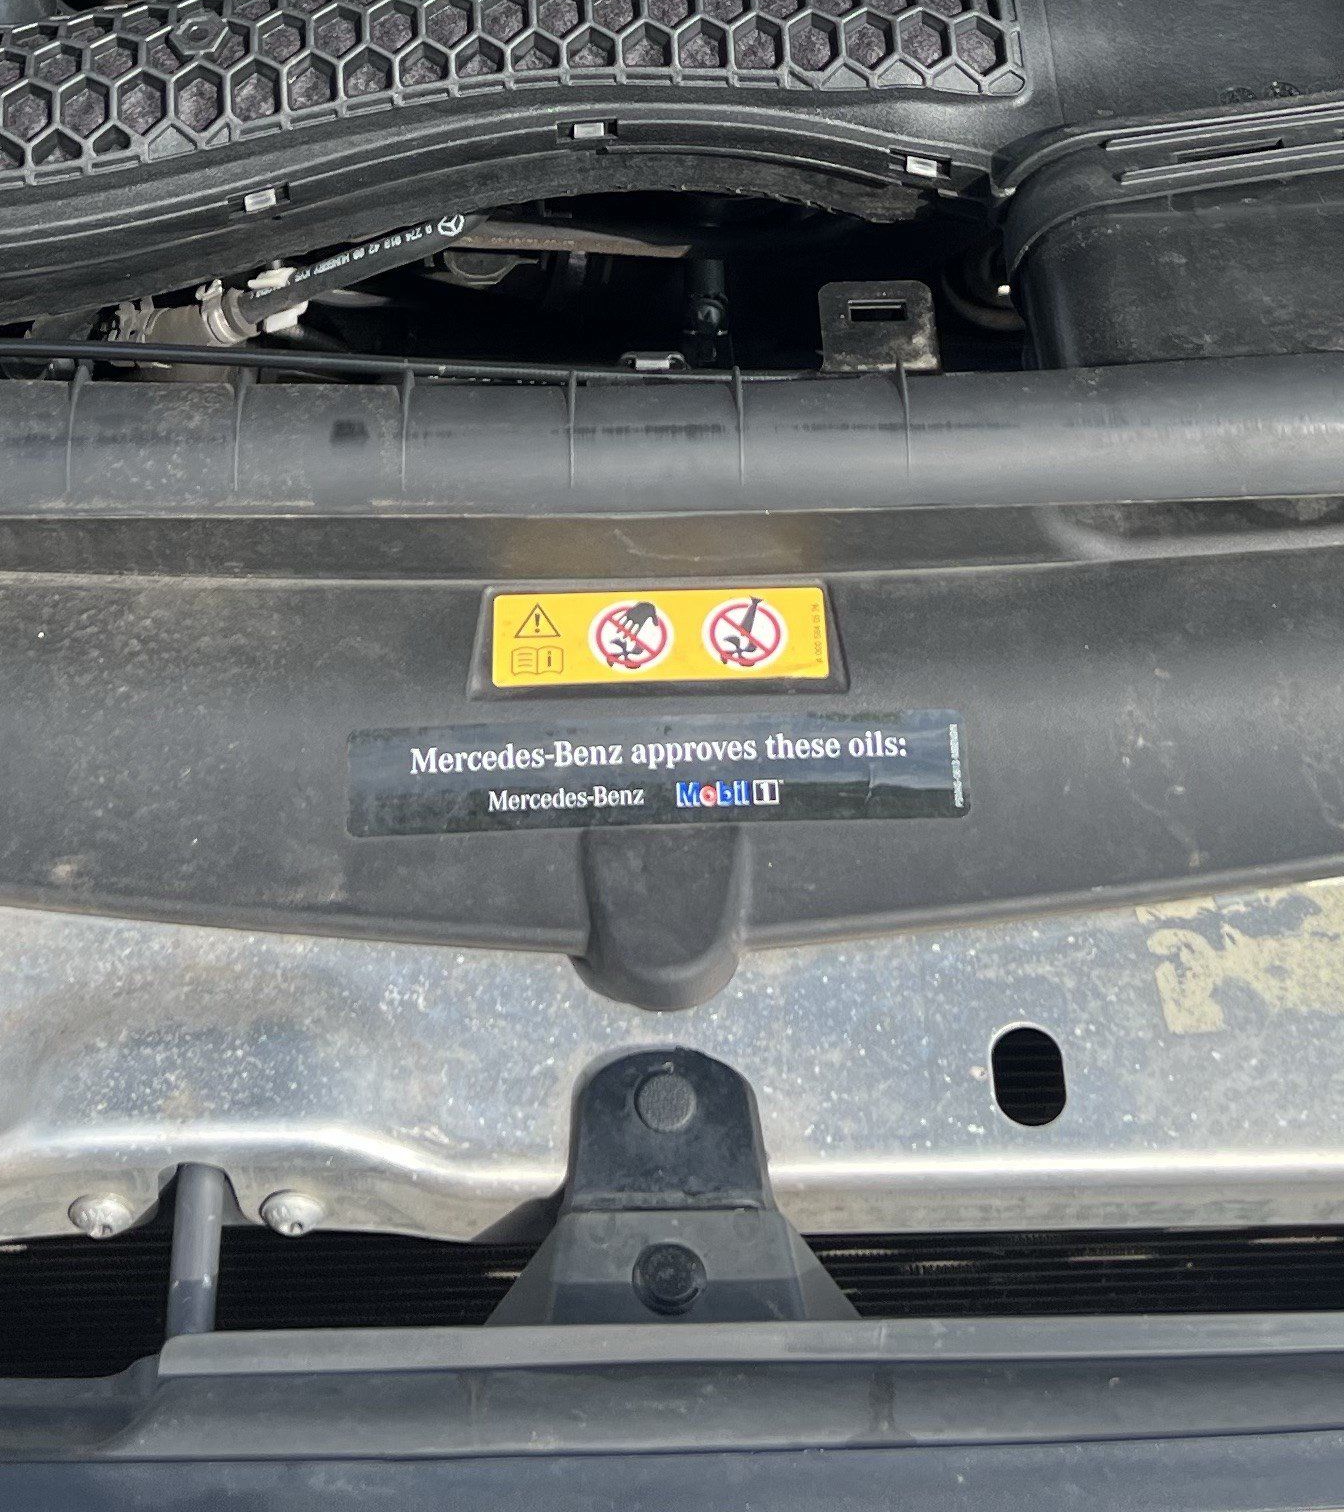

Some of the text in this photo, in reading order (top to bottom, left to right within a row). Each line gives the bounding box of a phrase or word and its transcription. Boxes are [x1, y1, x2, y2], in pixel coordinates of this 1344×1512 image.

[410, 731, 907, 774] Mercedes-Benz approves these oils:
[488, 786, 645, 812] Mercedes-Benz
[676, 780, 751, 808] Mobil
